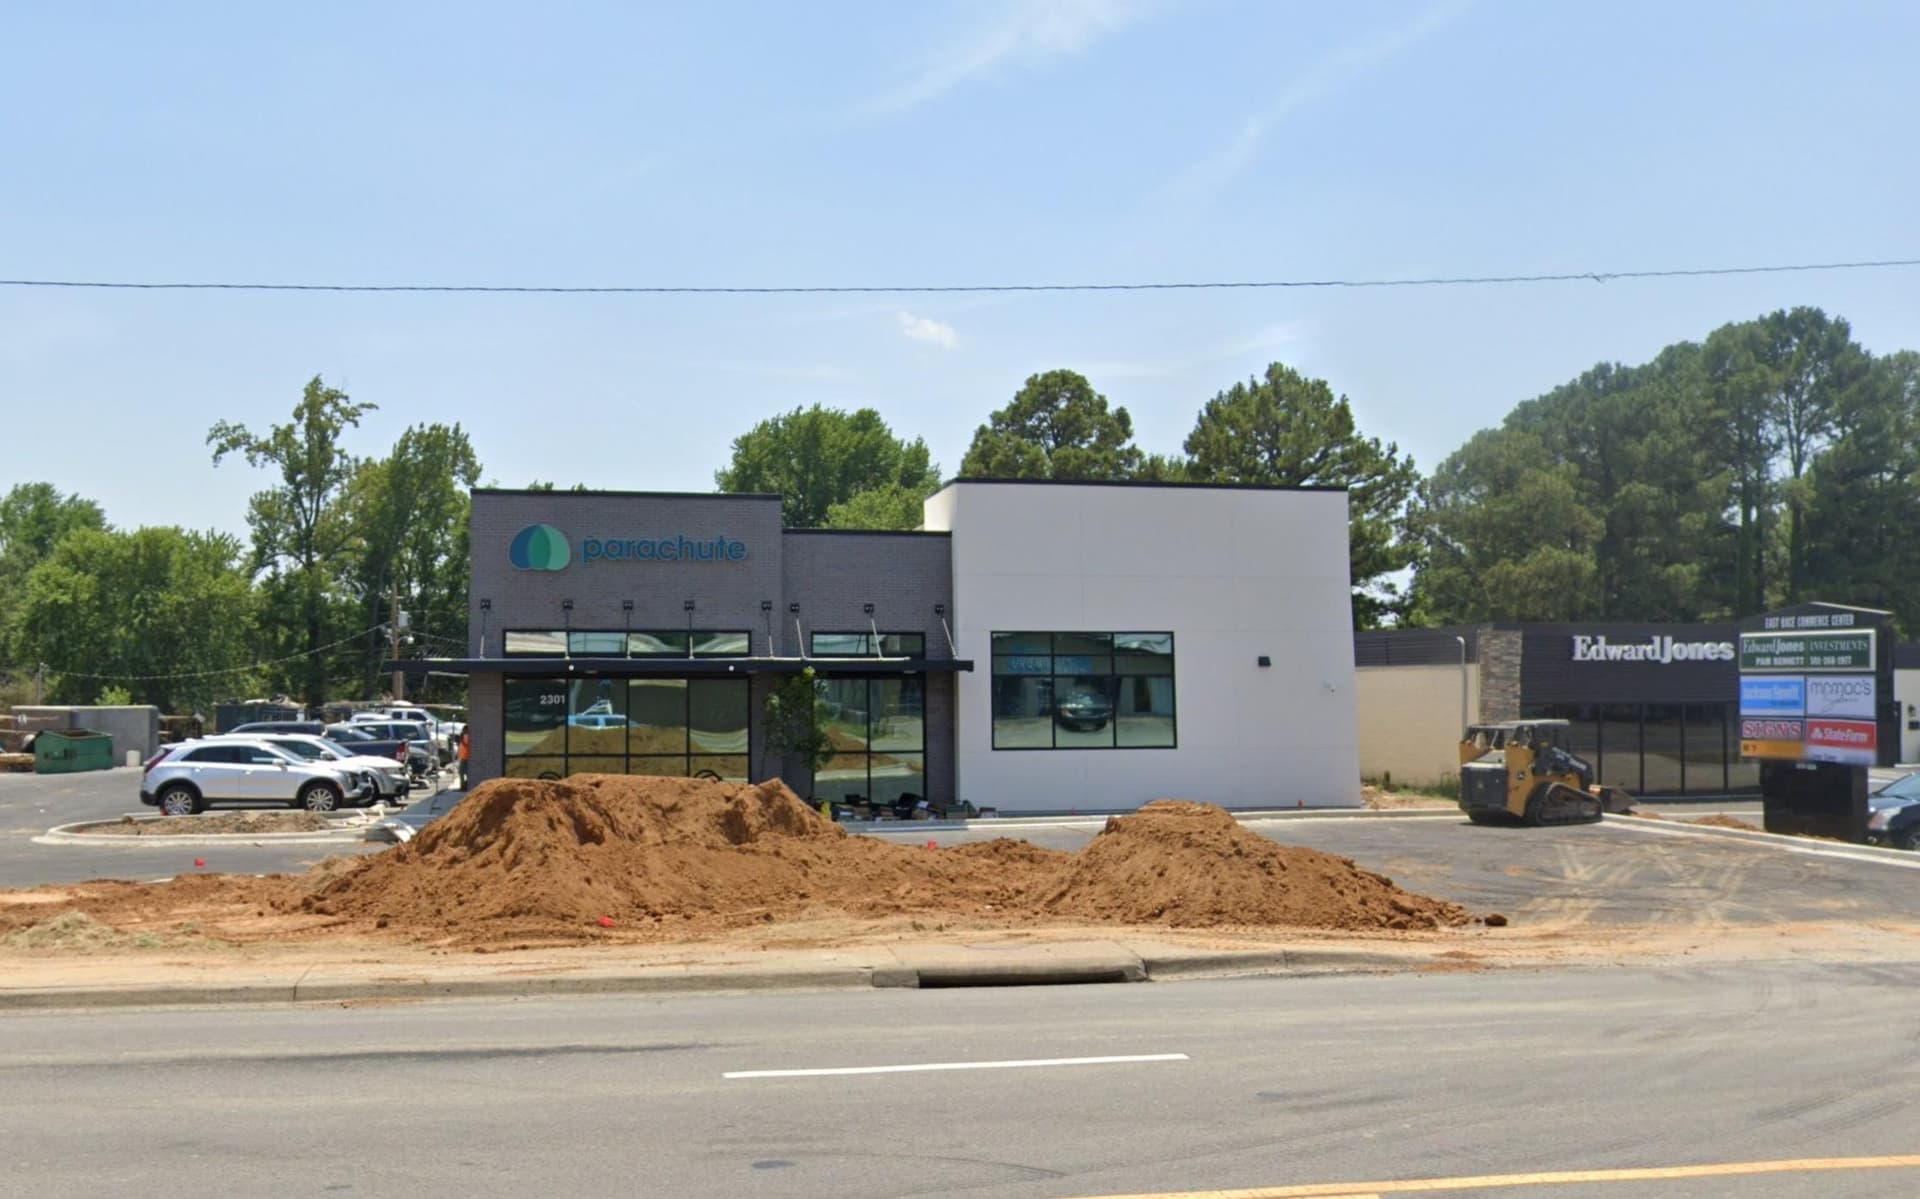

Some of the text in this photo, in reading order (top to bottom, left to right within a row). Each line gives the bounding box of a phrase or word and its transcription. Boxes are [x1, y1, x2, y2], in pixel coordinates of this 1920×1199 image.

[582, 534, 747, 564] parachute
[1830, 613, 1855, 627] CENTER
[1809, 639, 1869, 652] INVESTMENTS
[540, 694, 566, 704] 2301
[1742, 720, 1802, 739] SIGNS
